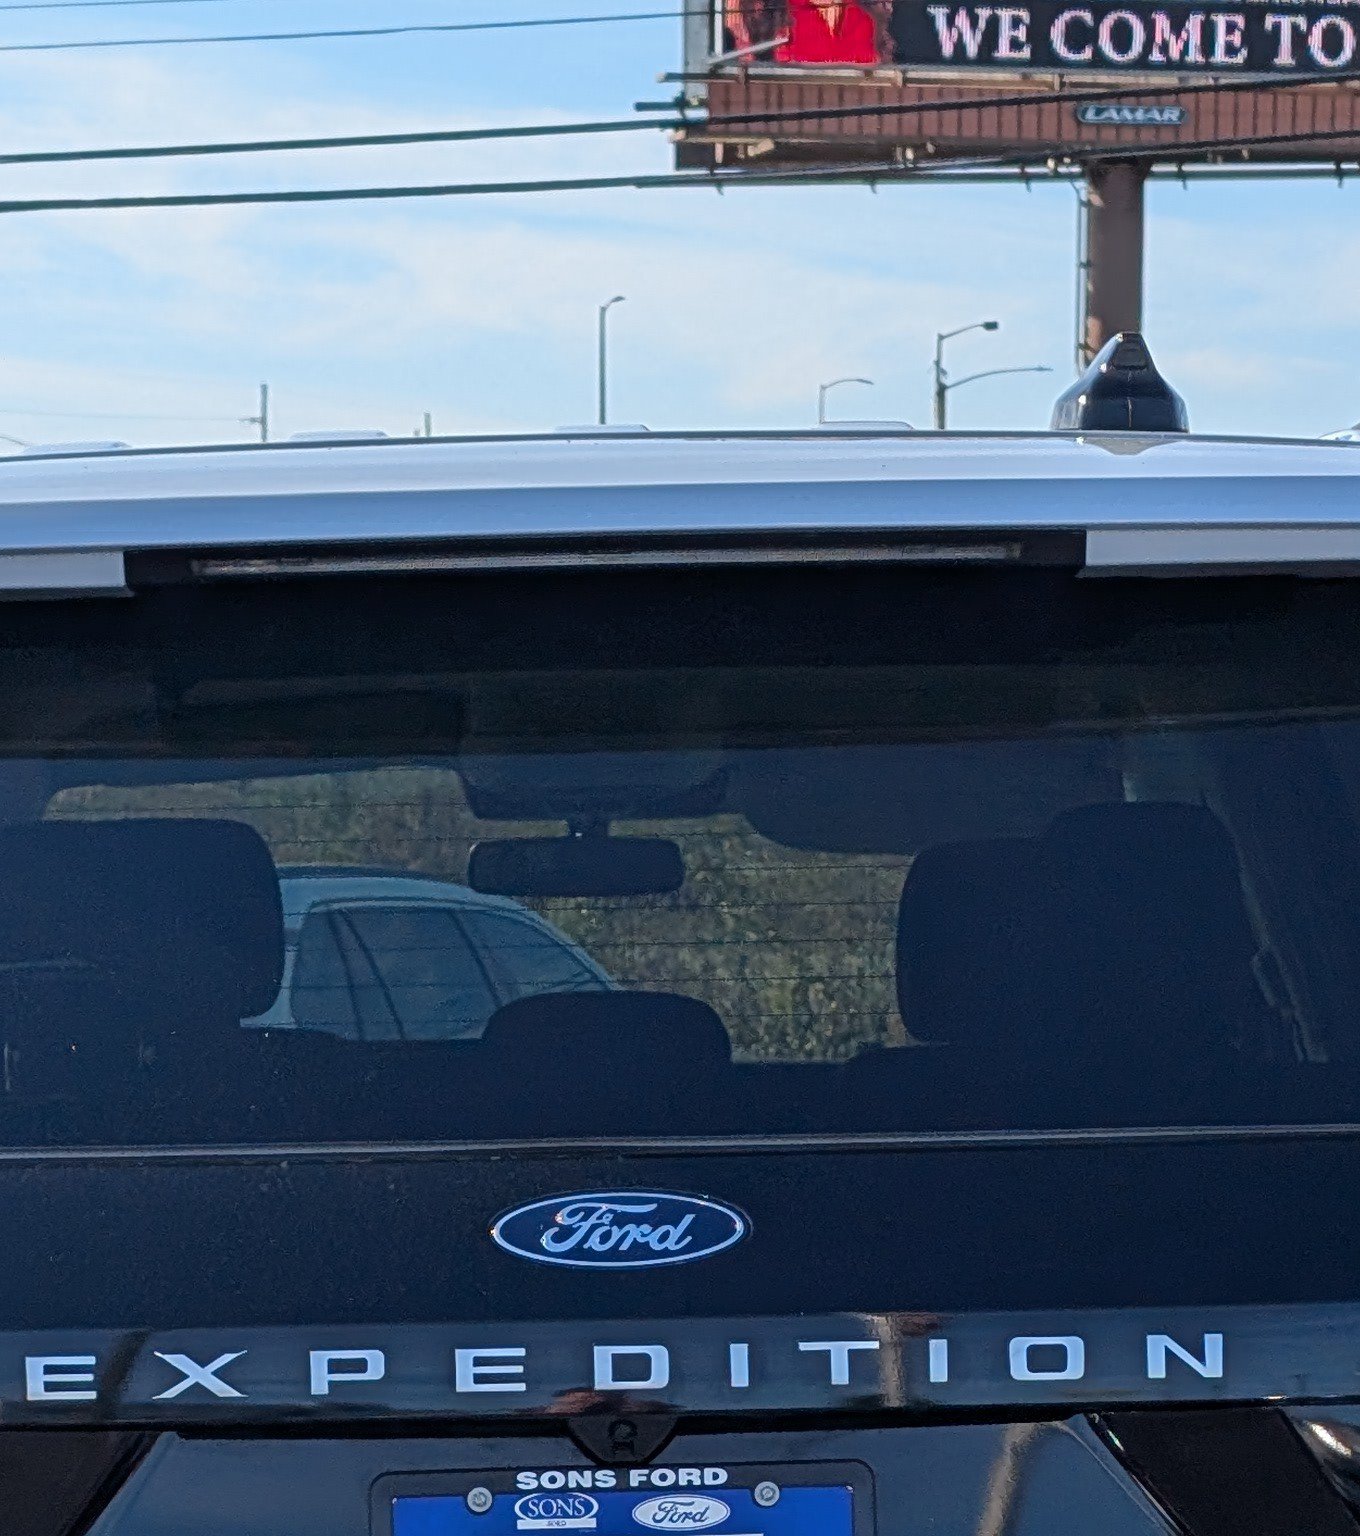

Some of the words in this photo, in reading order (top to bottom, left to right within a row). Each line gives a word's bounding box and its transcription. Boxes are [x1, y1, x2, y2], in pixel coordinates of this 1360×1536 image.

[927, 5, 1031, 60] WE
[1050, 8, 1248, 65] COME
[1264, 13, 1357, 67] TO
[1085, 105, 1181, 121] LAMAR
[540, 1202, 697, 1252] Ford
[24, 1333, 1224, 1401] EXPEDITION
[516, 1470, 617, 1490] SONS
[629, 1467, 728, 1487] FORD
[527, 1498, 586, 1517] SONS
[651, 1501, 711, 1524] Ford
